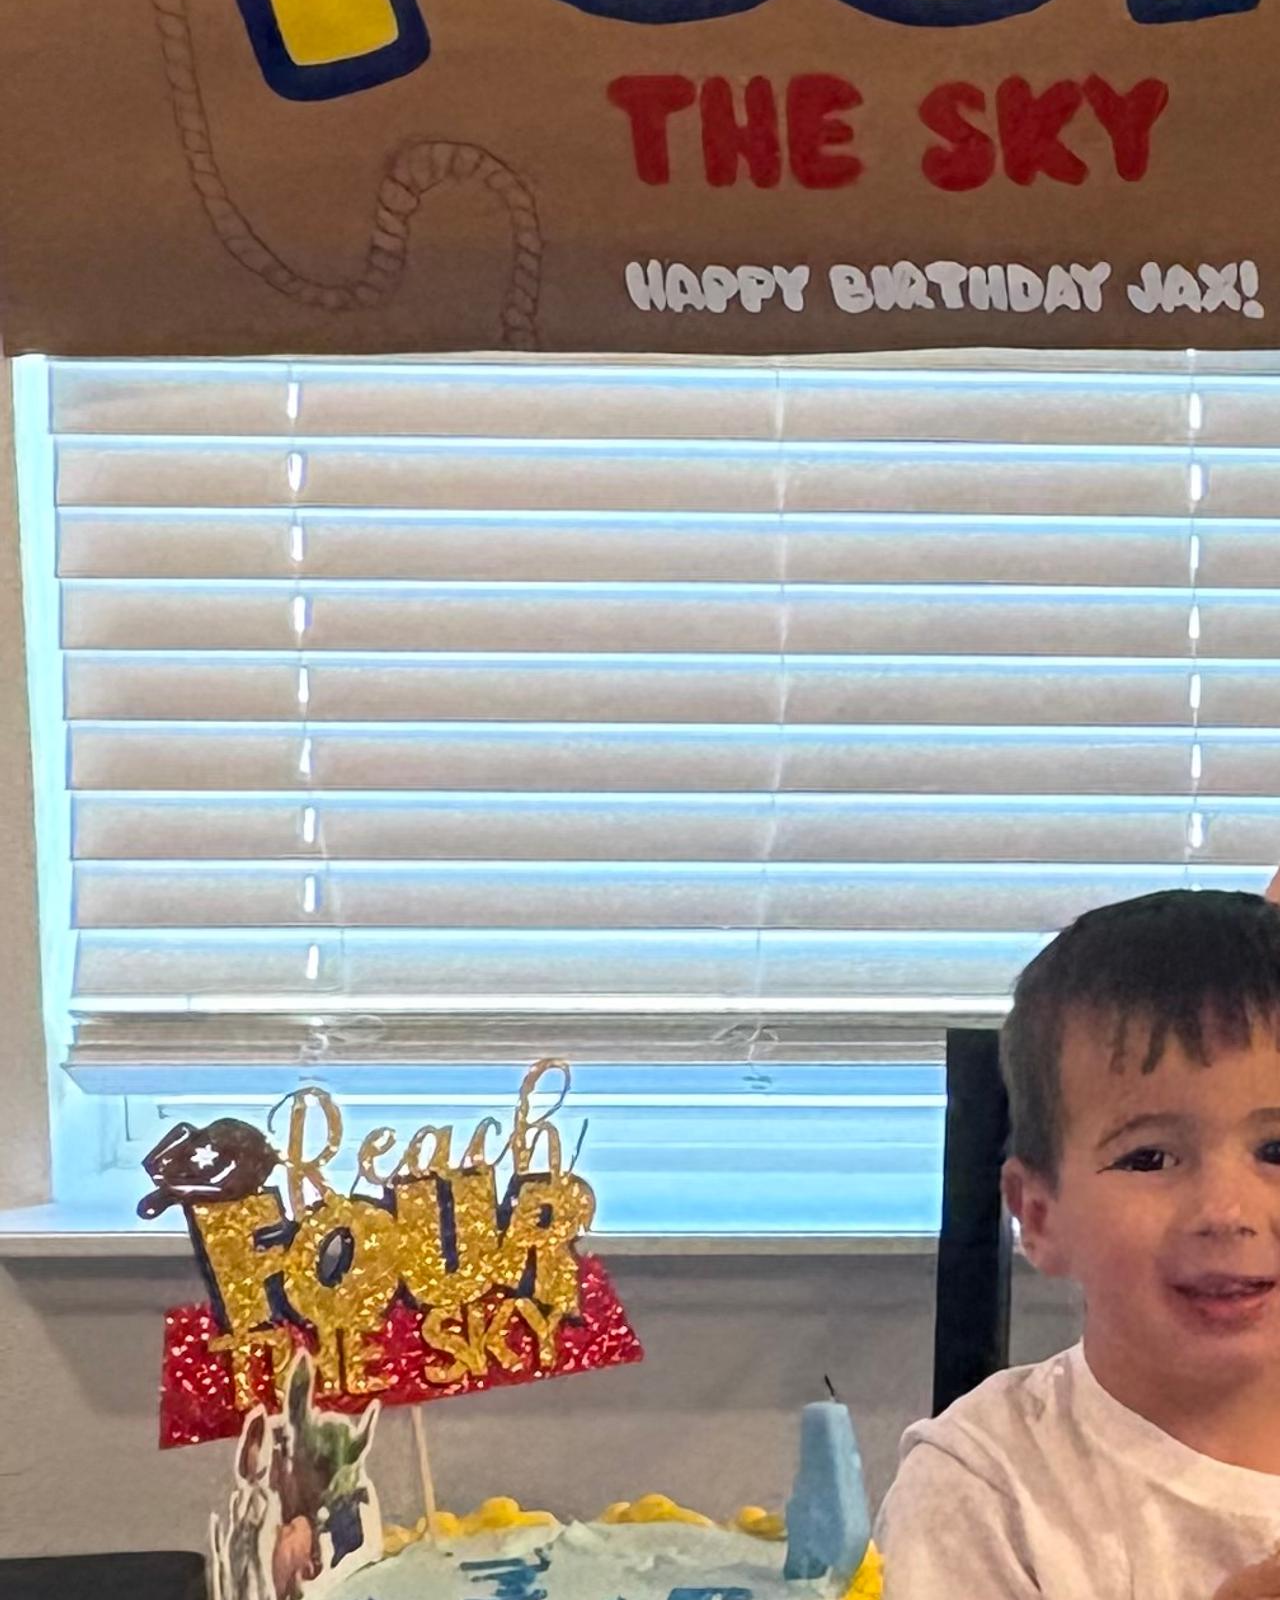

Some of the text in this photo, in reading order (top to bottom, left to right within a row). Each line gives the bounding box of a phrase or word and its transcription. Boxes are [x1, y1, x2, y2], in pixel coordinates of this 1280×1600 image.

[606, 72, 1170, 192] THE SKY
[624, 258, 1265, 319] HAPPY BIRTHDAY JAX!
[266, 1056, 590, 1208] Reach
[184, 1170, 596, 1336] FOUR
[420, 1294, 566, 1386] SKY
